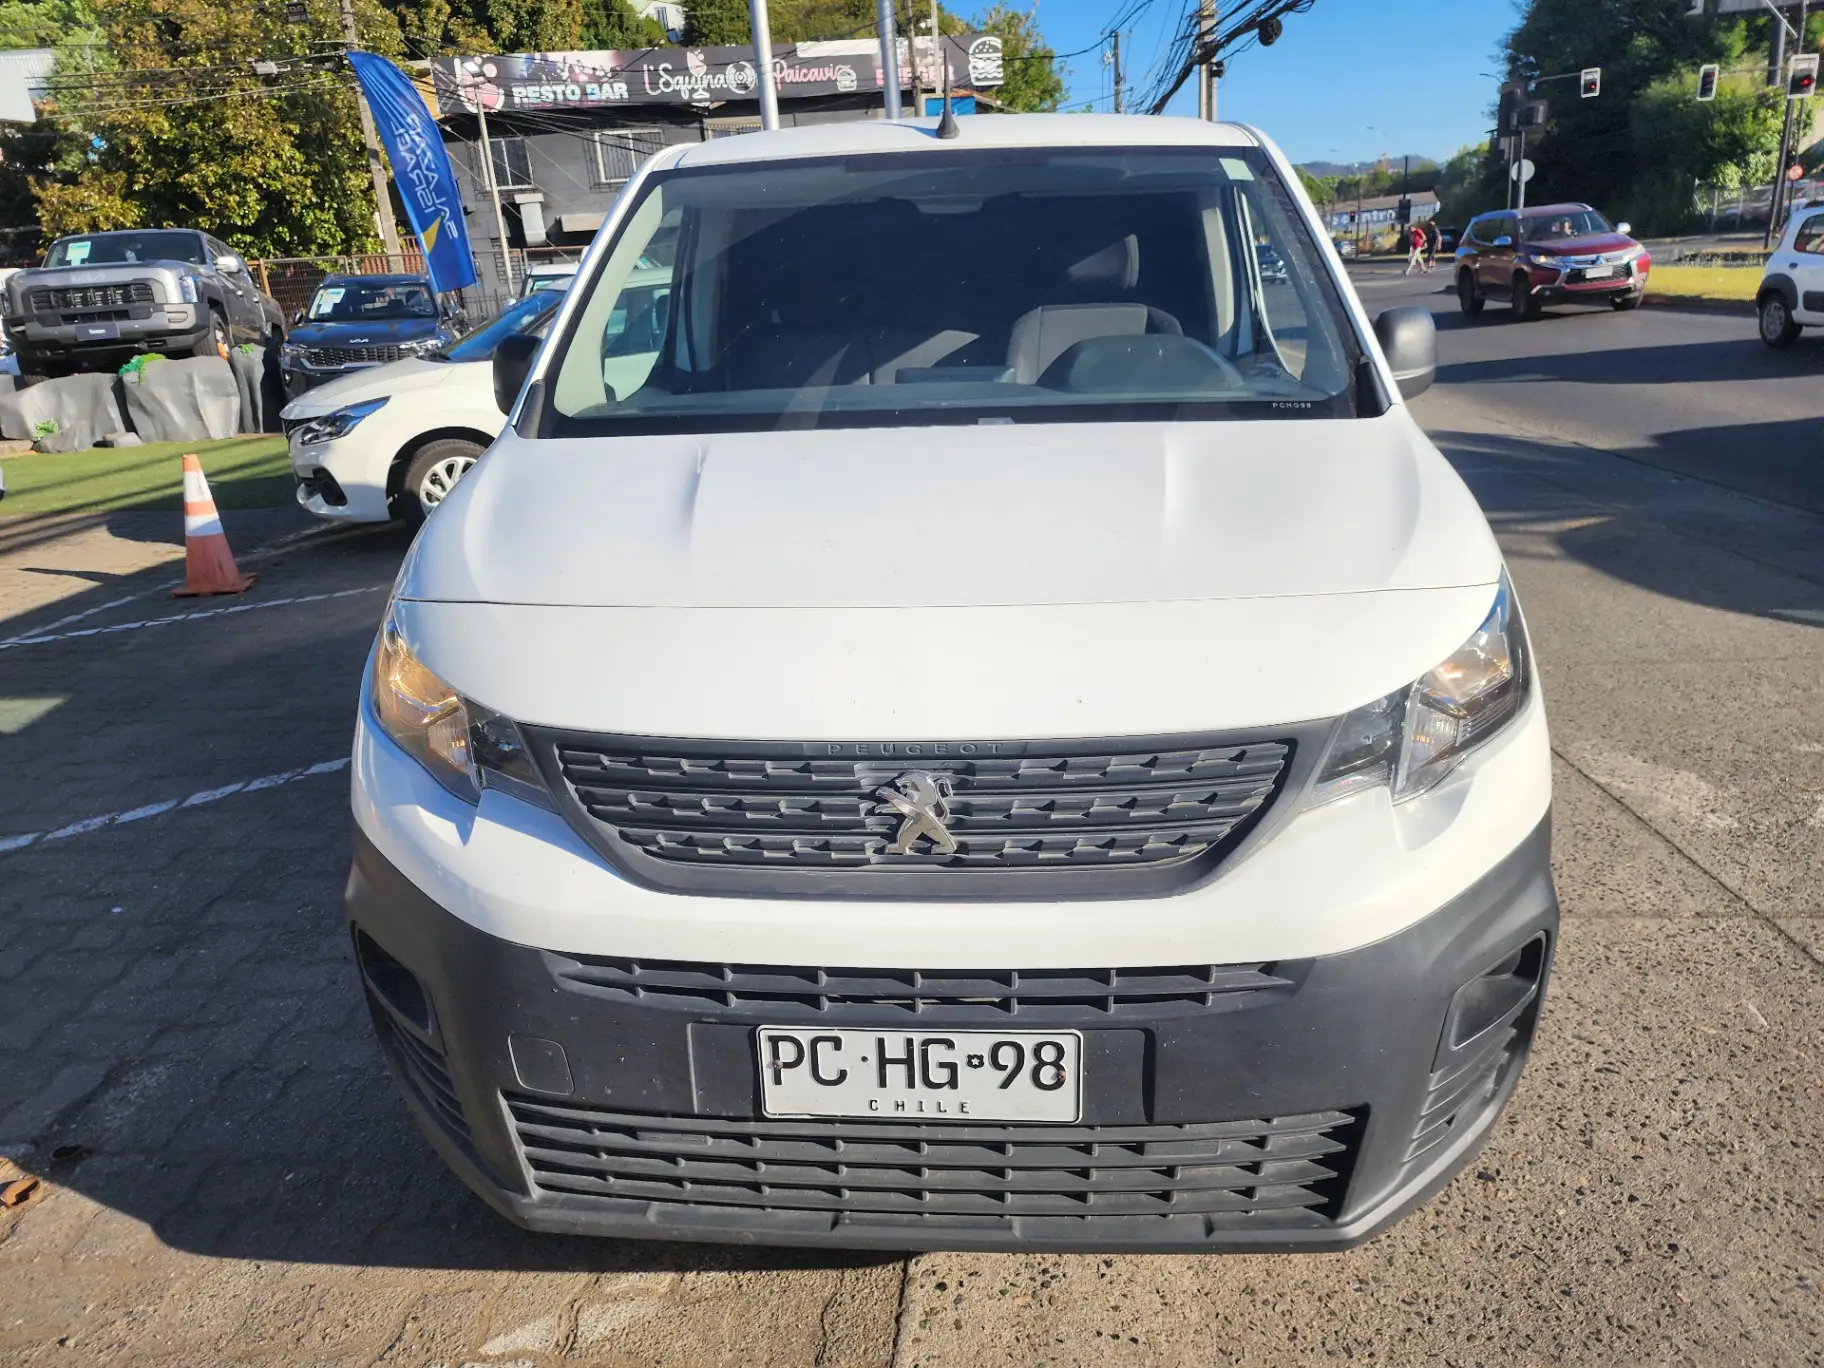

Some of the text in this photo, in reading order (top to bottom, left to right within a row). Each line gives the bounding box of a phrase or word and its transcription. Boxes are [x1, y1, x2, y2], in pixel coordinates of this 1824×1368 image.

[511, 81, 629, 104] RESTO BAR
[827, 742, 1004, 756] PEUGEOT
[868, 1098, 971, 1114] CHILE
